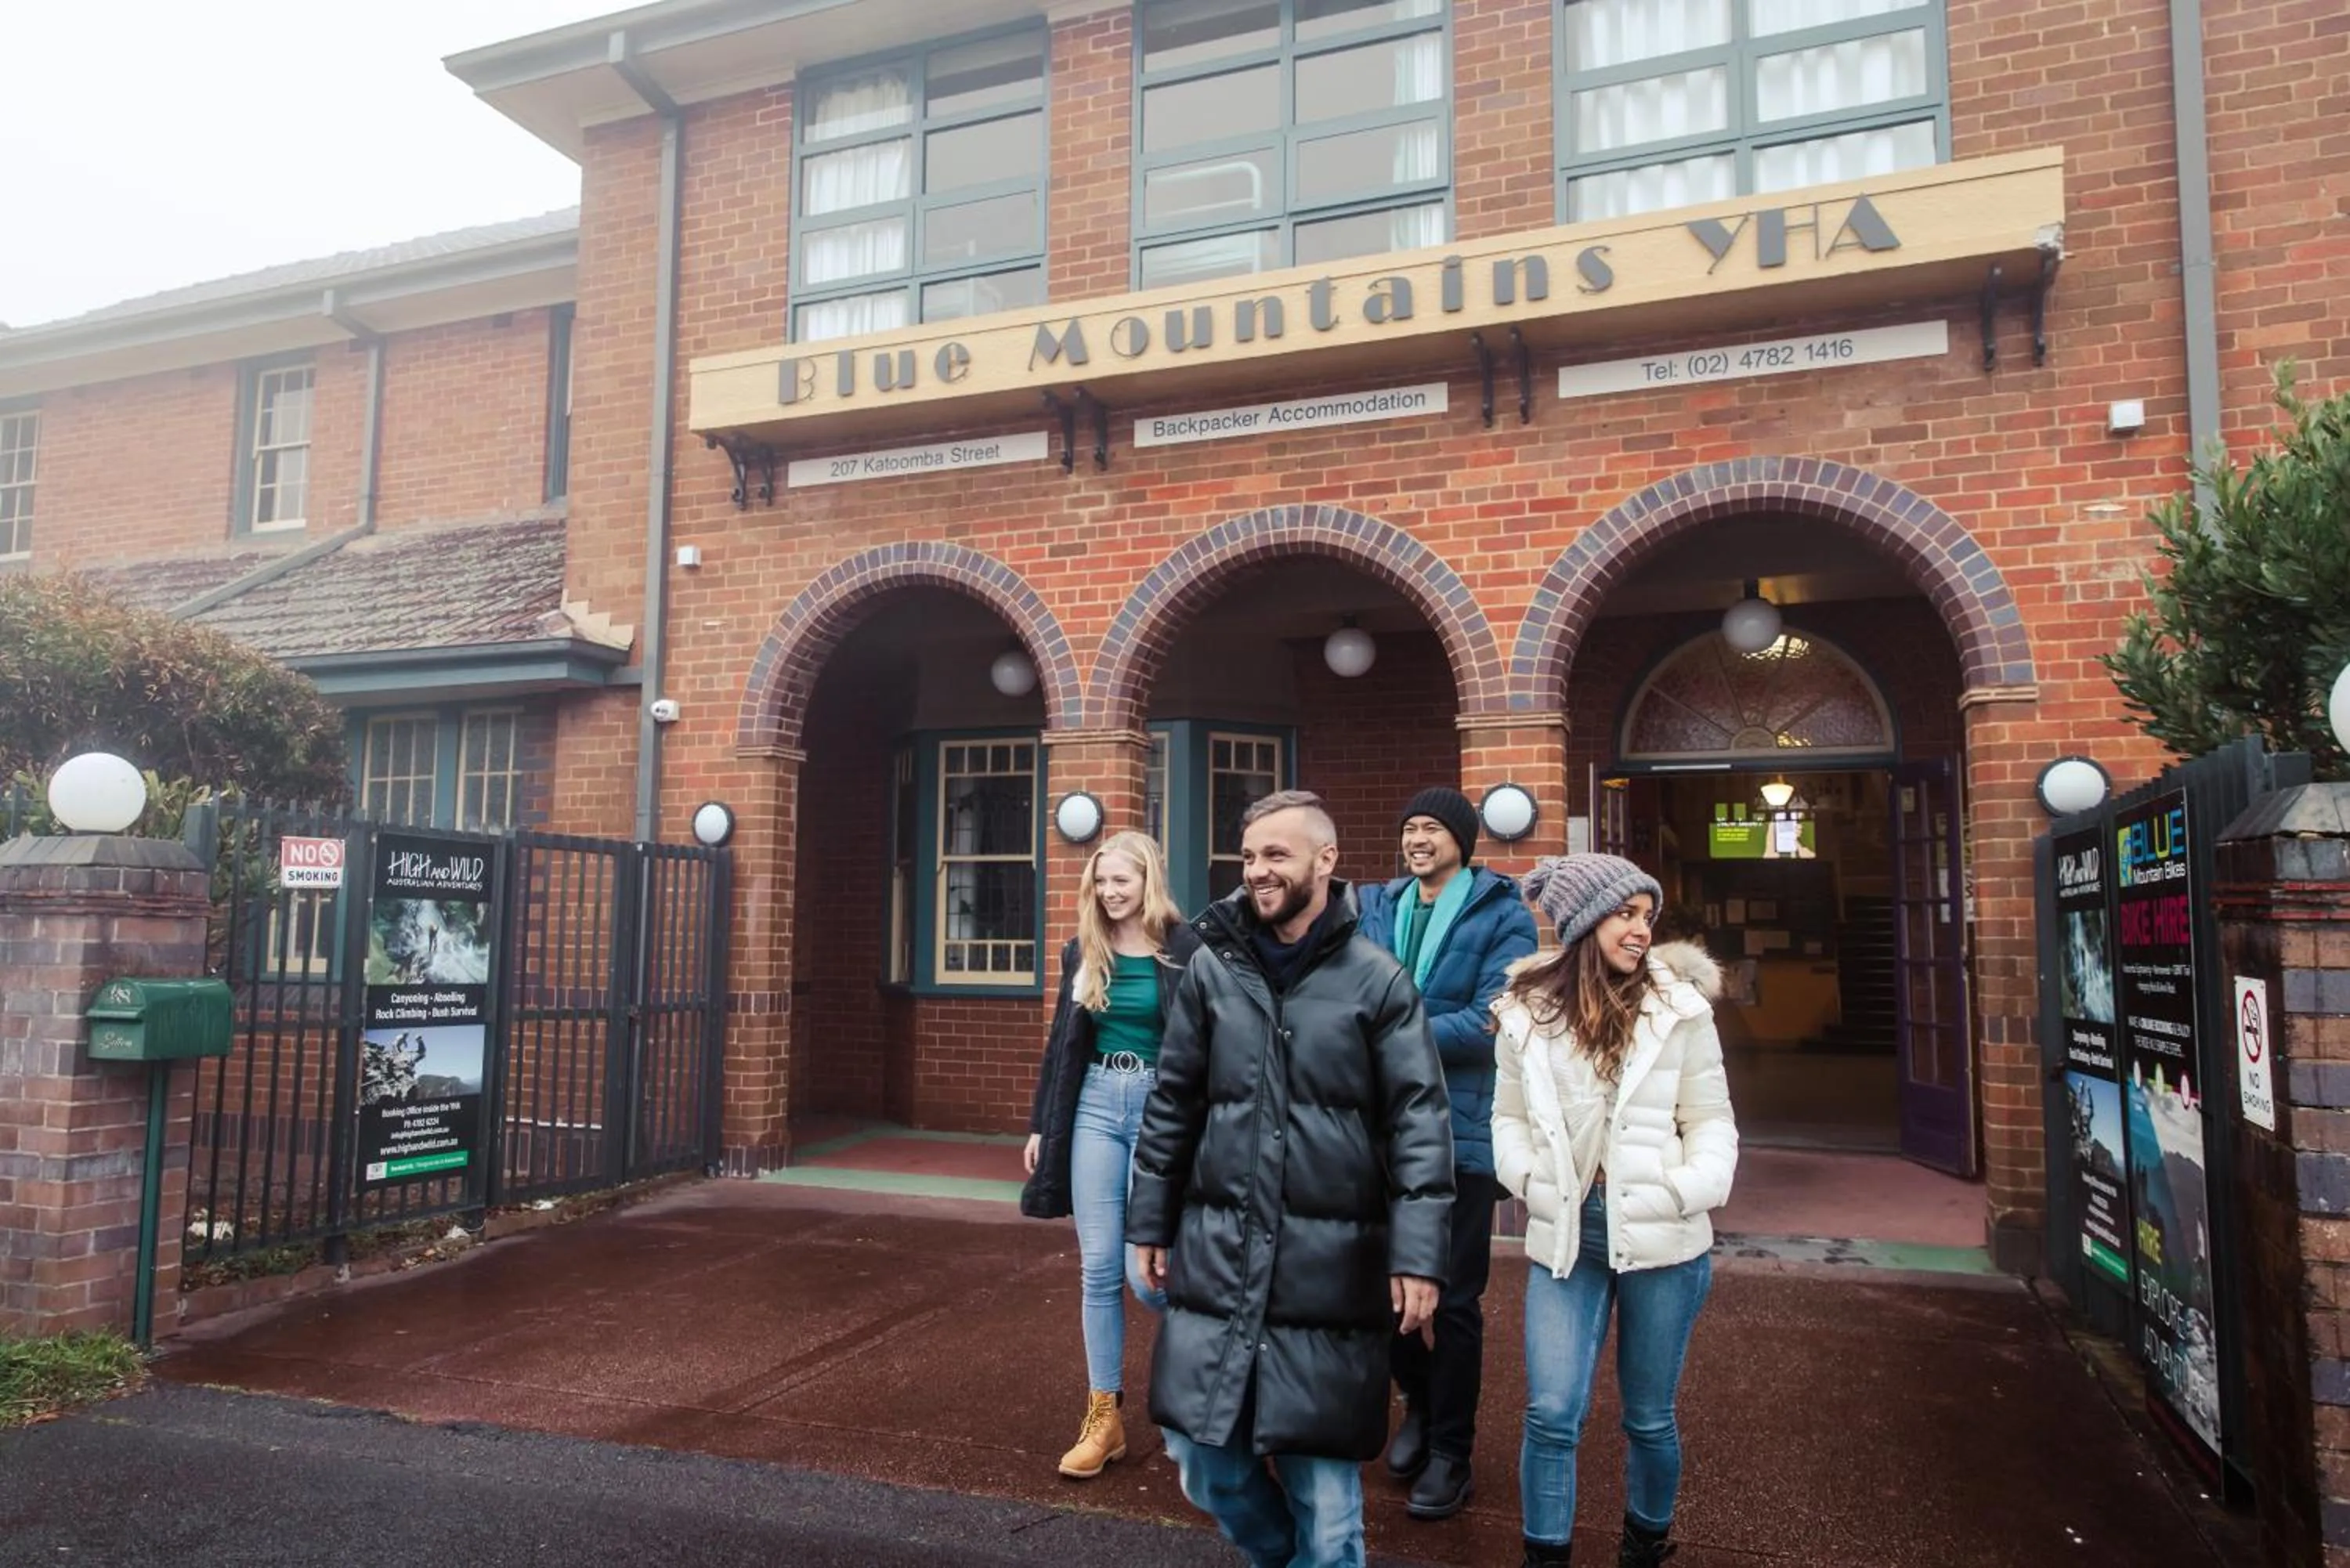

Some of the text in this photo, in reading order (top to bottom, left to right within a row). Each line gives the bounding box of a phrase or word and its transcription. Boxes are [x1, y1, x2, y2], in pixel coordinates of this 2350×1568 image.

[778, 192, 1901, 406] Blue Mountains YHA
[1641, 338, 1853, 381] Tel: (02) 4782 1416
[1152, 392, 1426, 439] Backpacker Accommodation
[830, 443, 1001, 478] 207 Katoomba Street
[2131, 808, 2186, 865] BLUE
[290, 843, 314, 864] NO
[388, 851, 432, 878] HIGH
[450, 856, 483, 882] WILD
[287, 870, 338, 882] SMOKING
[2164, 860, 2186, 880] Bikes
[386, 878, 483, 893] AUSTRALIAN ADVENTURES
[2120, 894, 2190, 945] BIKE HIRE
[391, 992, 428, 1006] Canyoning
[375, 1008, 394, 1020] Rock
[395, 1007, 427, 1020] Climbing
[450, 1005, 477, 1017] Survival
[2248, 1070, 2260, 1089] NO
